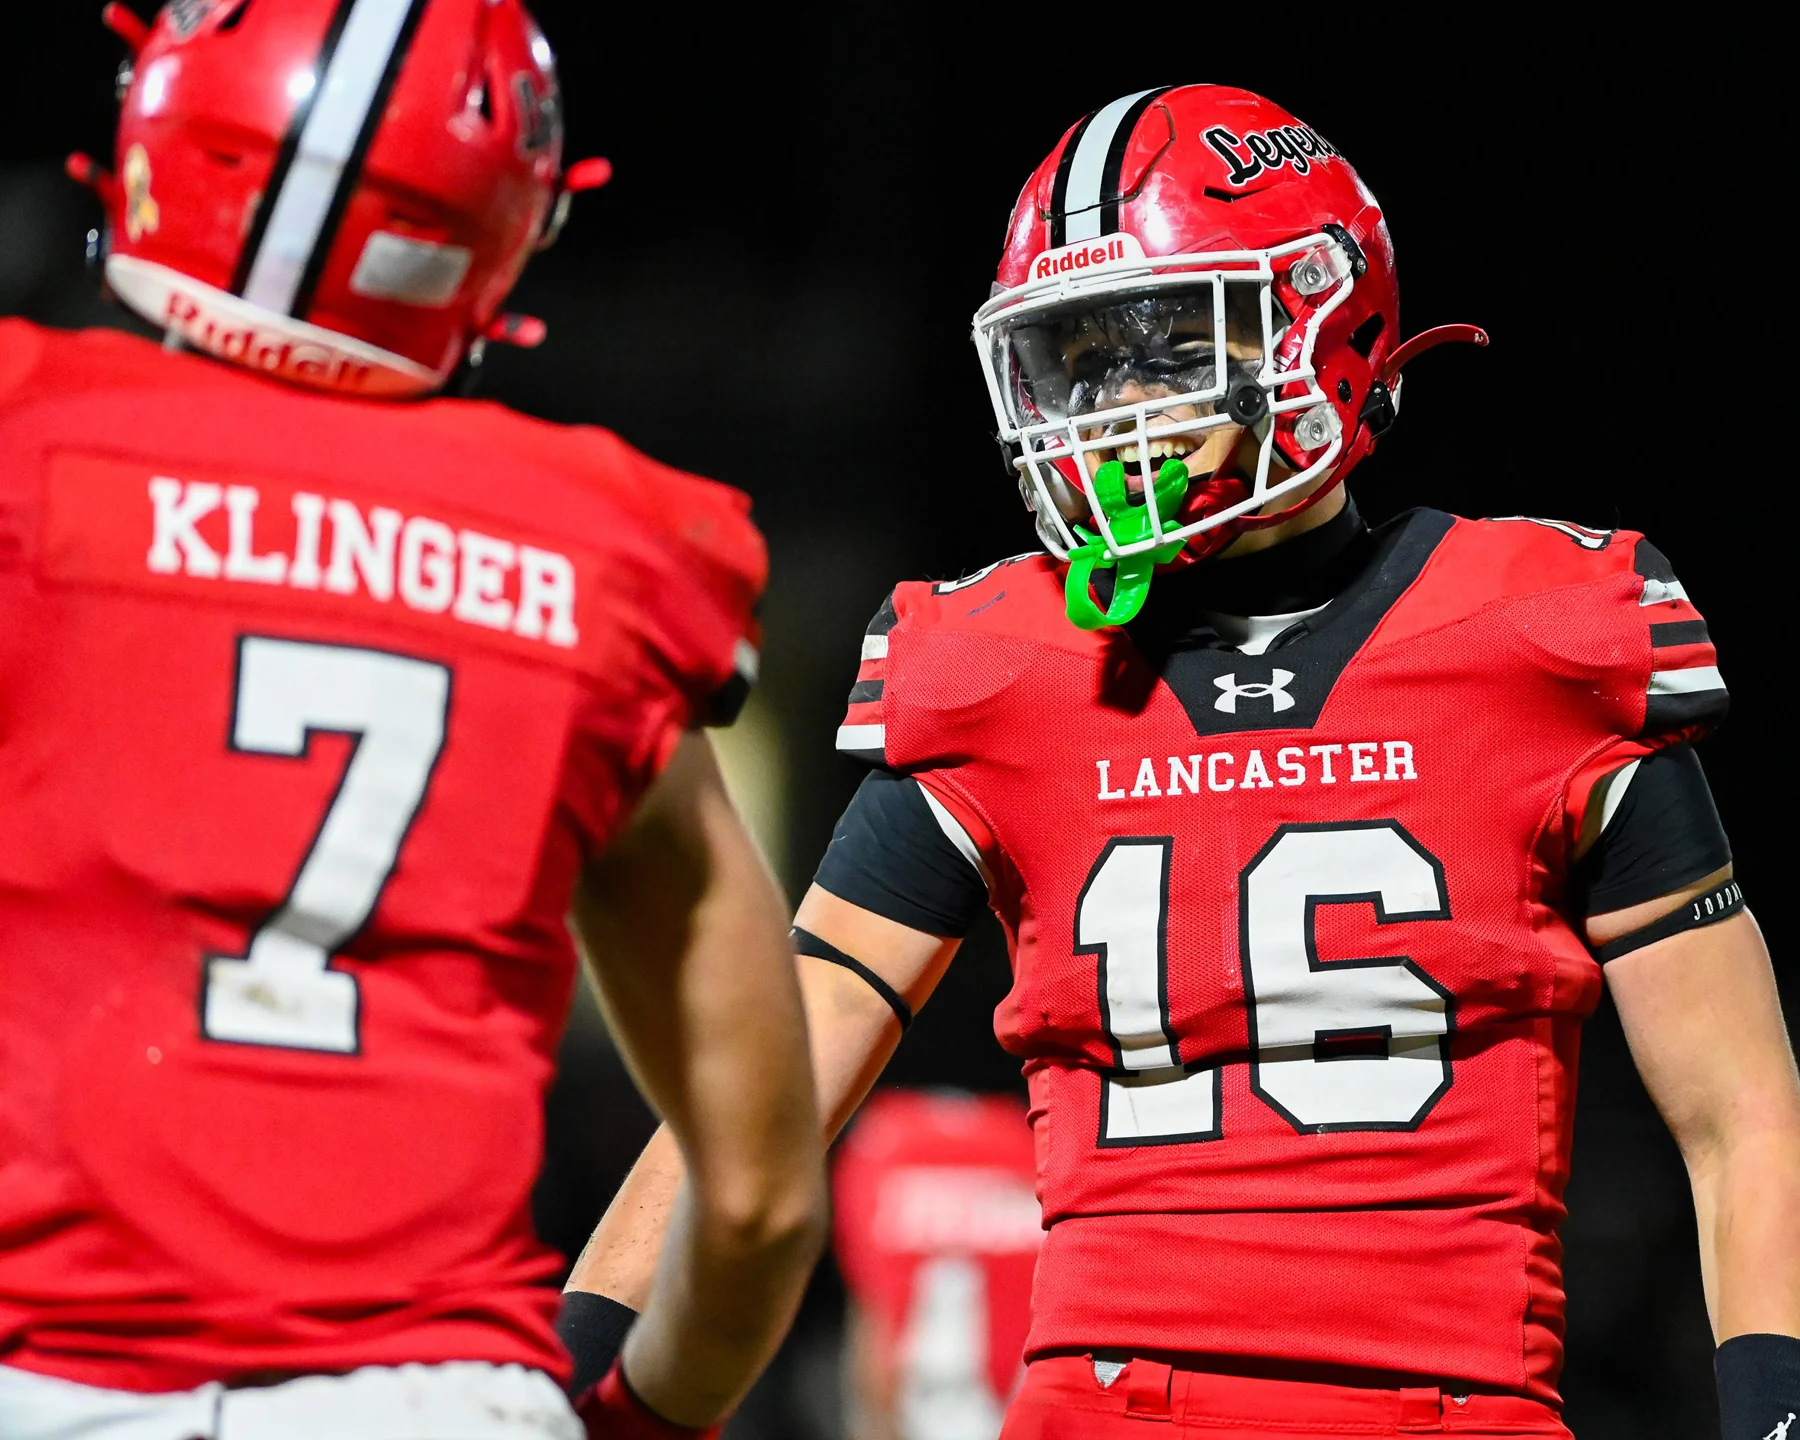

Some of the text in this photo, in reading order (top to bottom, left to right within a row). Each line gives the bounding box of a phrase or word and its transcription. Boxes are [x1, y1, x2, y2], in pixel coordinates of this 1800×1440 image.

[1036, 240, 1125, 279] Riddell
[163, 287, 372, 386] Riddell
[146, 475, 579, 648] KLINGER
[1096, 740, 1418, 801] LANCASTER
[200, 632, 454, 1056] 7
[1073, 817, 1457, 1148] 16
